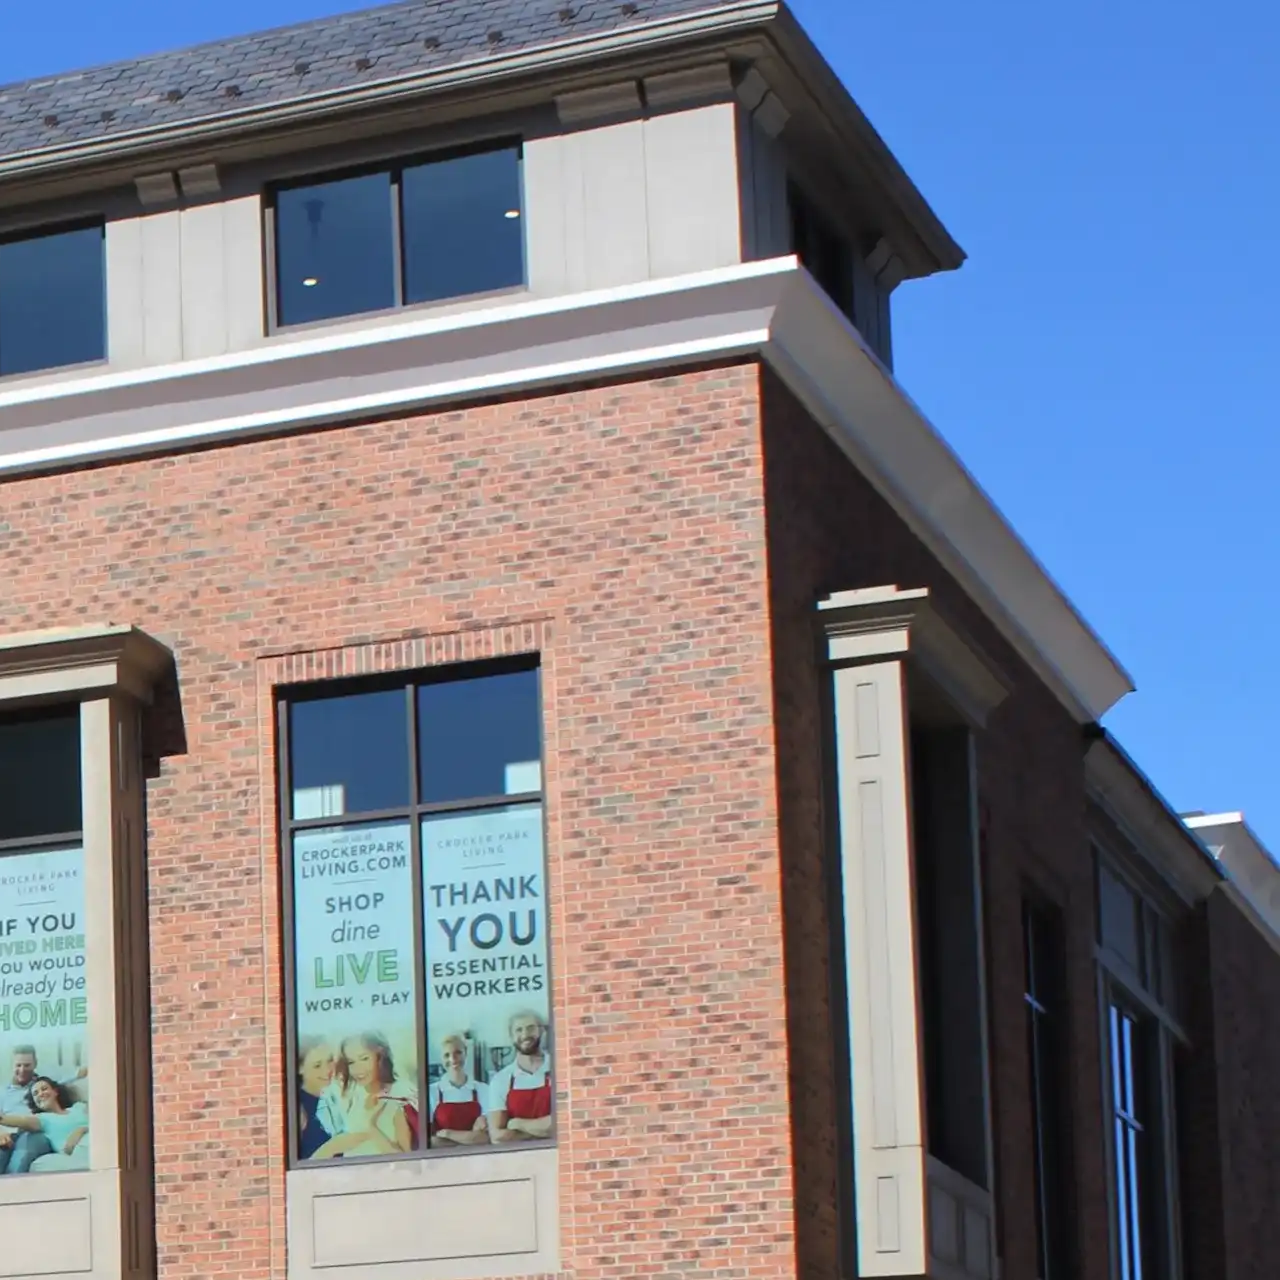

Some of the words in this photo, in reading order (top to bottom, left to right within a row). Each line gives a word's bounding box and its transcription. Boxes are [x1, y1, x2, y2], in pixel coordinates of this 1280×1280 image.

[302, 841, 404, 862] CROCKERPARK
[302, 855, 406, 879] LIVING.COM
[430, 874, 538, 908] THANK
[325, 892, 385, 914] SHOP
[27, 913, 76, 934] YOU
[331, 920, 380, 944] dine
[437, 909, 536, 952] YOU
[42, 934, 86, 951] HERE
[29, 956, 86, 971] WOULD
[314, 949, 399, 989] LIVE
[432, 954, 544, 978] ESSENTIAL
[63, 974, 86, 991] be
[434, 975, 543, 1000] WORKERS
[305, 998, 353, 1013] WORK
[371, 991, 410, 1006] PLAY
